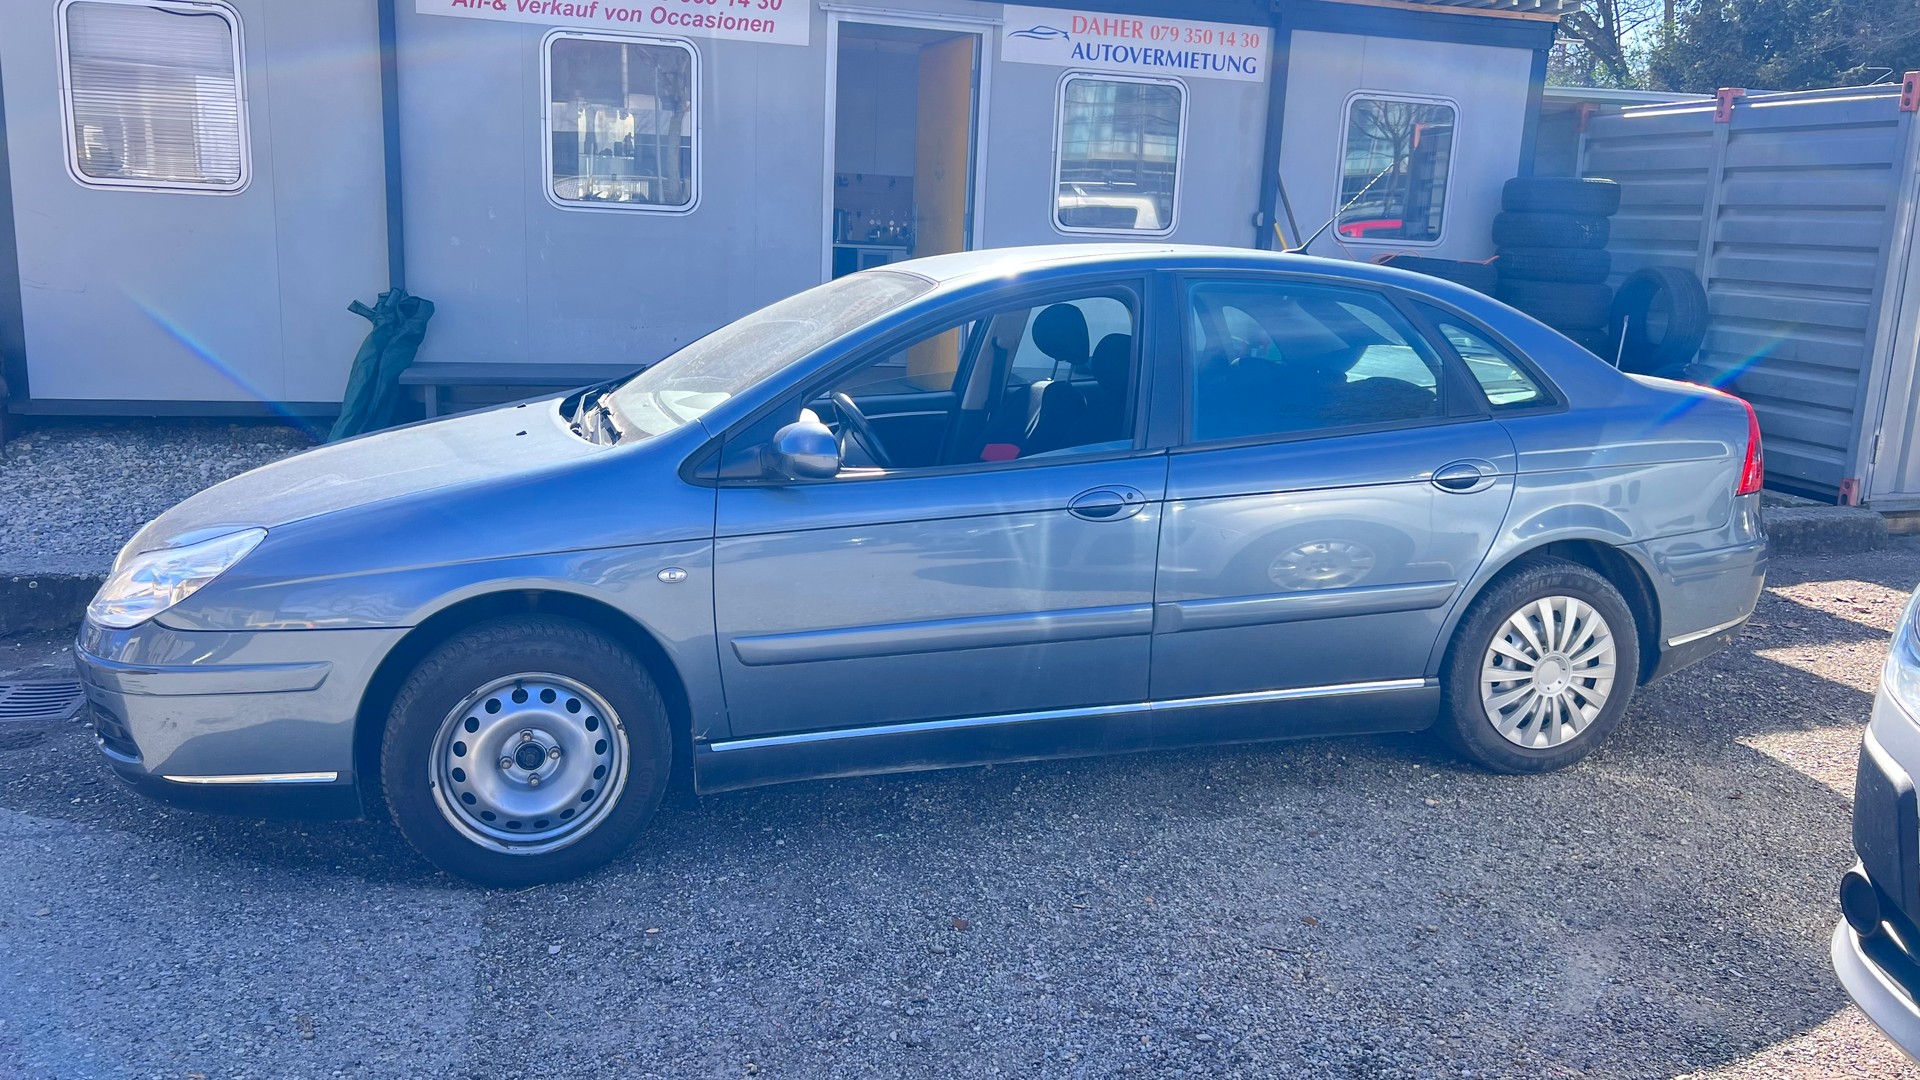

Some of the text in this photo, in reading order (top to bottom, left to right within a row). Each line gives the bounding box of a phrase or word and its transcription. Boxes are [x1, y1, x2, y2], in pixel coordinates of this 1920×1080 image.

[516, 0, 597, 18] Verkauf
[604, 7, 642, 23] von
[650, 6, 775, 33] Occasionen
[1071, 15, 1260, 48] DAHER 079 350 14 30
[1071, 41, 1257, 74] AUTOVERMIETUNG
